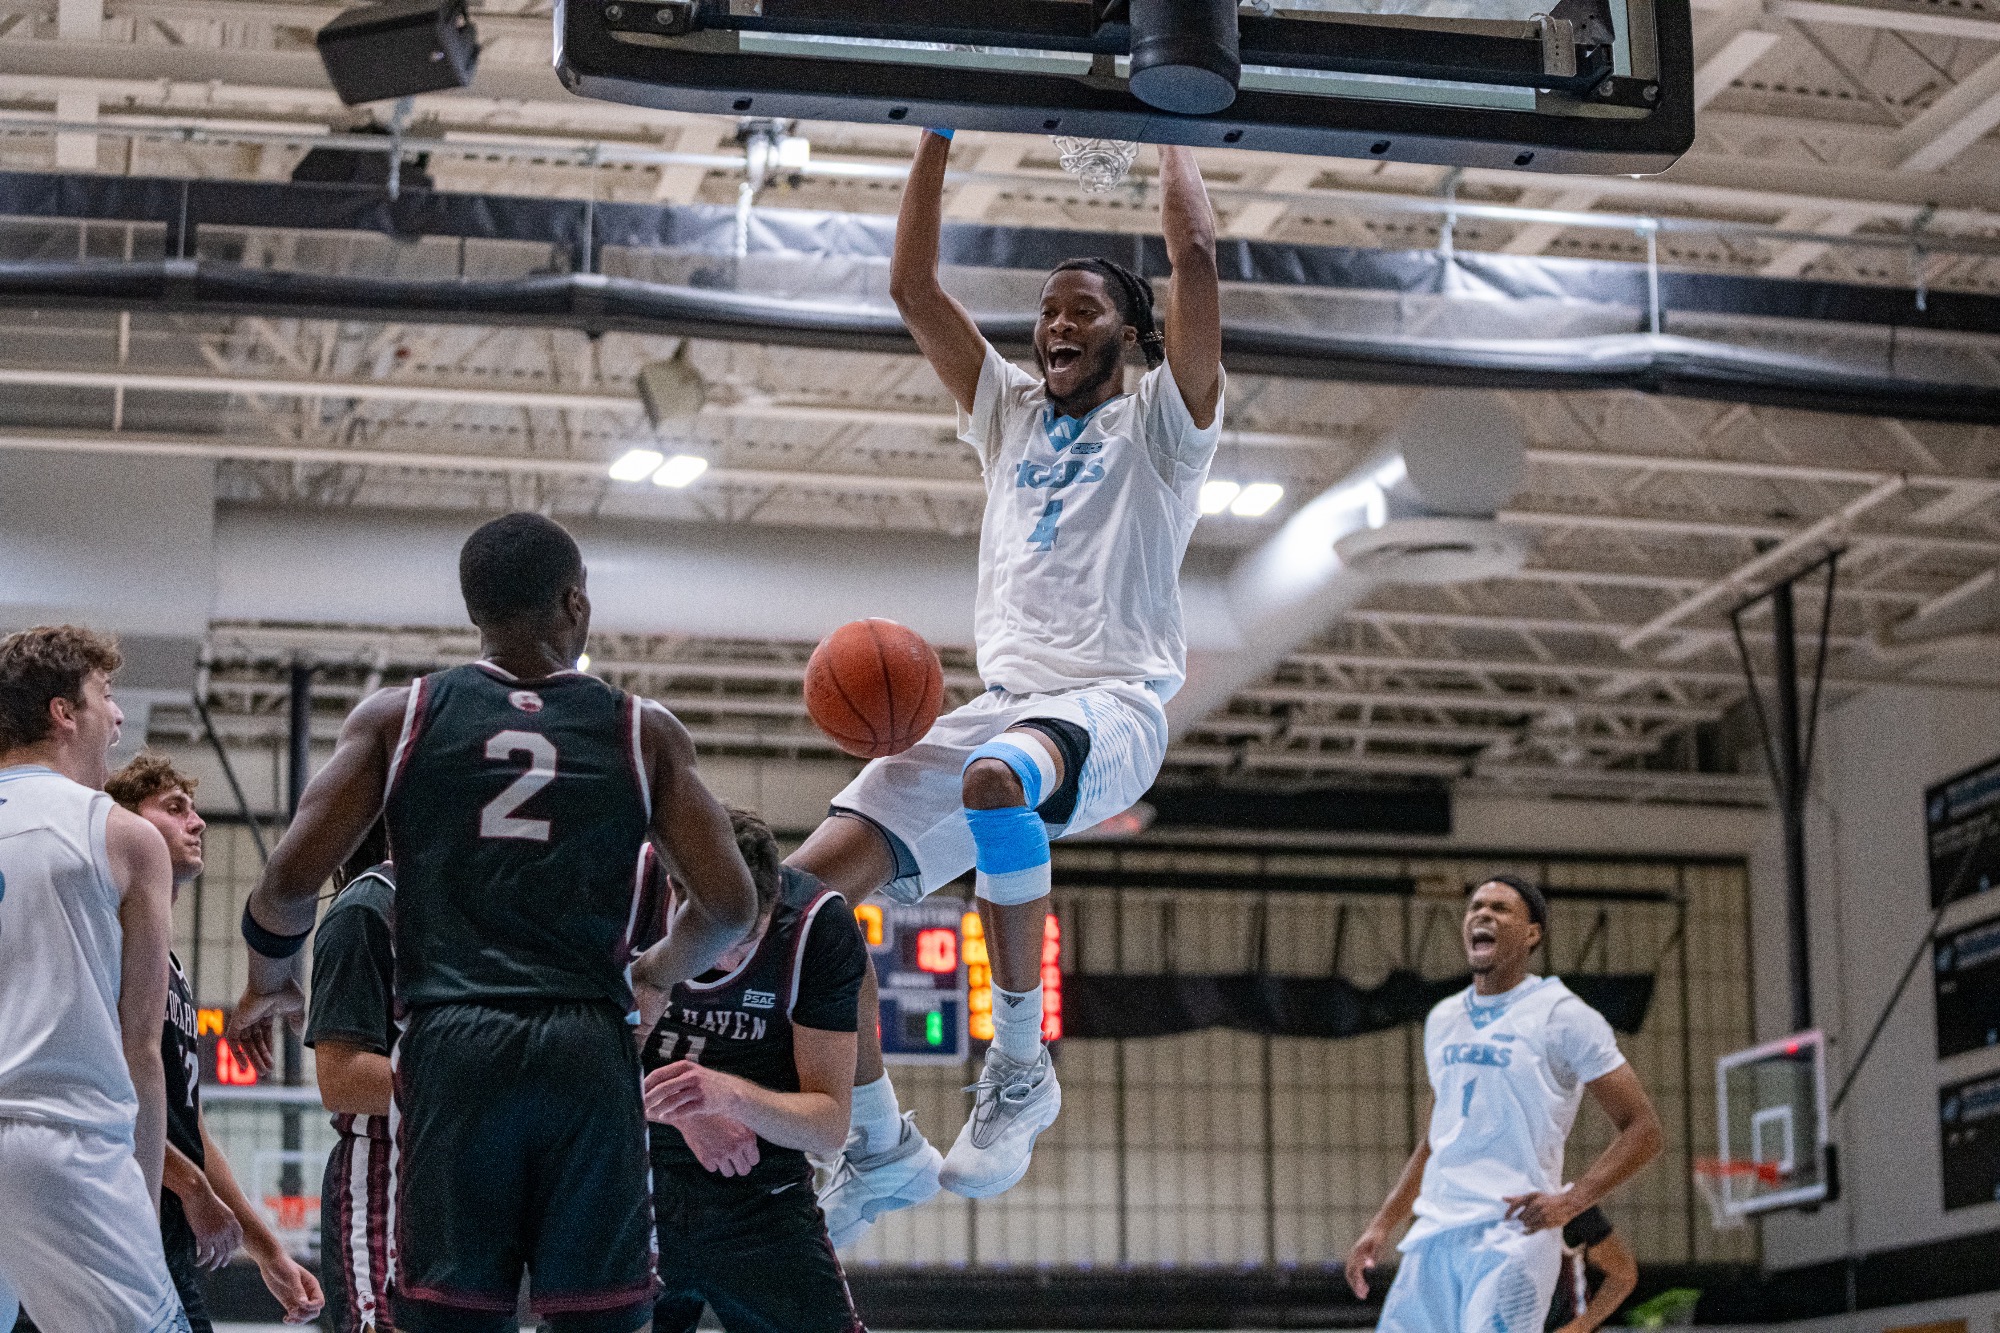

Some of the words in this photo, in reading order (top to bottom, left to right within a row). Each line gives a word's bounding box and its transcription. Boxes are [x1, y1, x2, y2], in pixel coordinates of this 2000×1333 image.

[1026, 499, 1064, 553] 4
[479, 729, 558, 842] 2
[917, 929, 957, 973] 10
[743, 992, 776, 1006] PSAC
[682, 1008, 767, 1041] HAVEN
